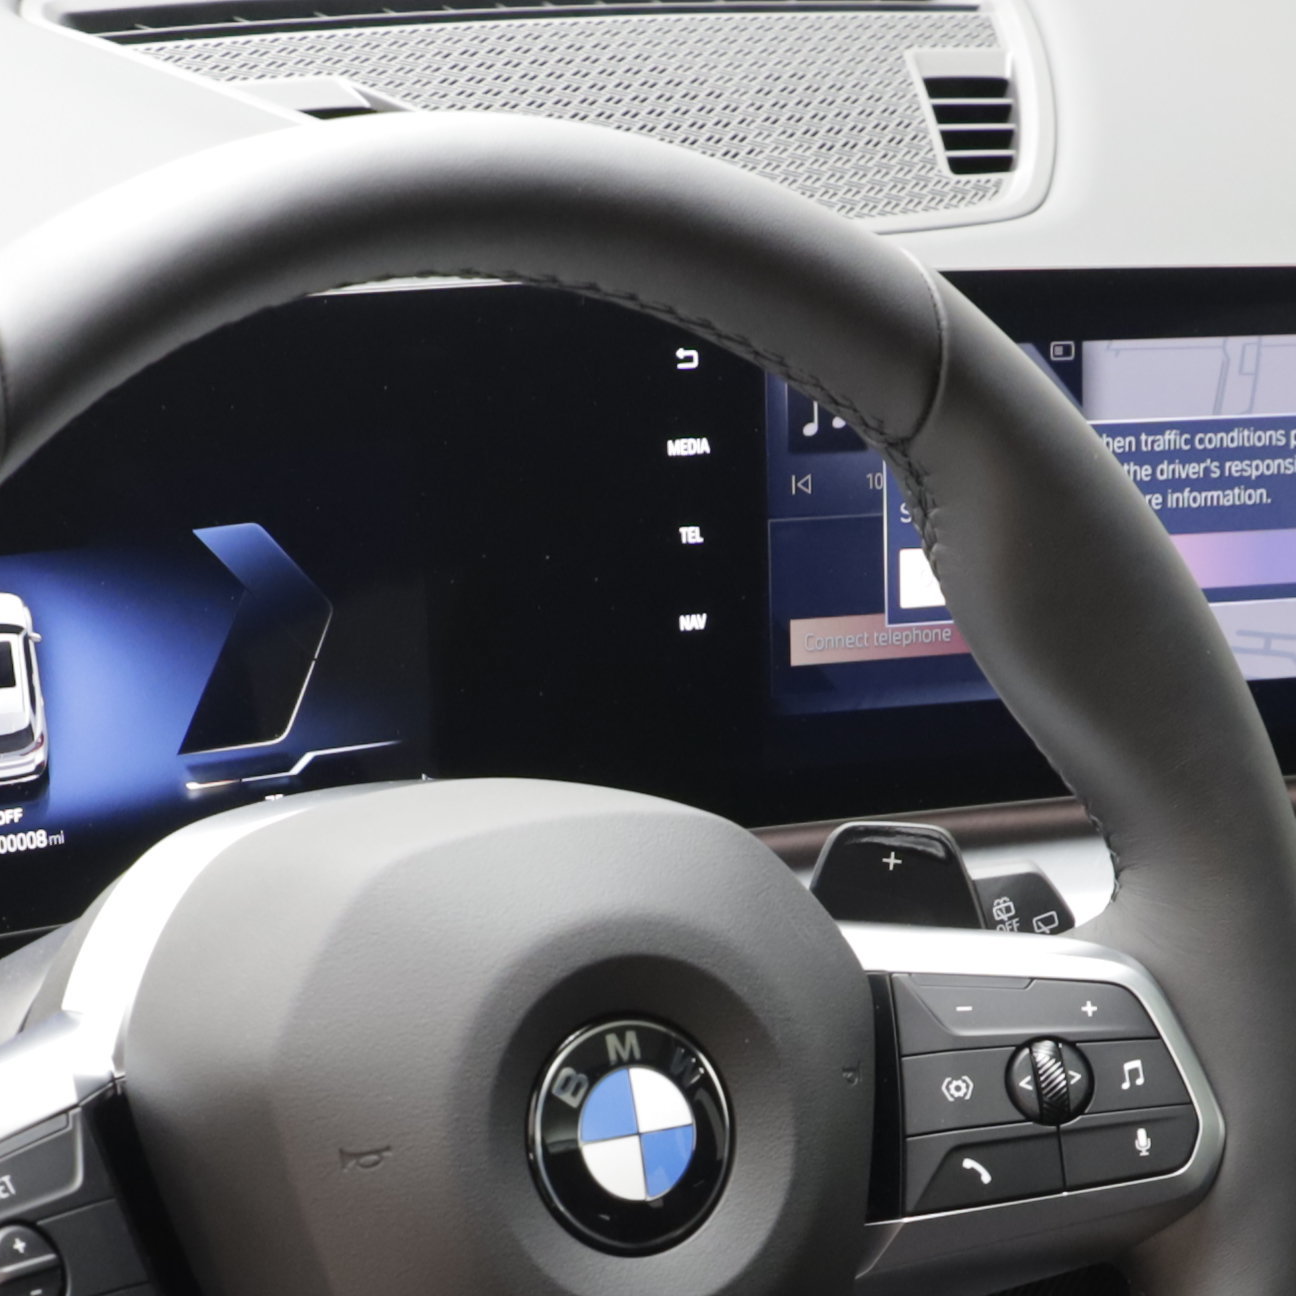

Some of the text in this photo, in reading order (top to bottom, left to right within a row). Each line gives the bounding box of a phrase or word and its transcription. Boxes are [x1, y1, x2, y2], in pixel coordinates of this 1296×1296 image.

[667, 437, 710, 456] MEDIA
[1102, 433, 1136, 453] hen
[1141, 429, 1191, 451] traffic
[1195, 427, 1286, 449] conditions
[1156, 459, 1221, 481] driver's
[1167, 485, 1272, 509] information.
[679, 526, 703, 543] TEL
[679, 613, 706, 631] NAV
[804, 627, 952, 651] Connect telephone
